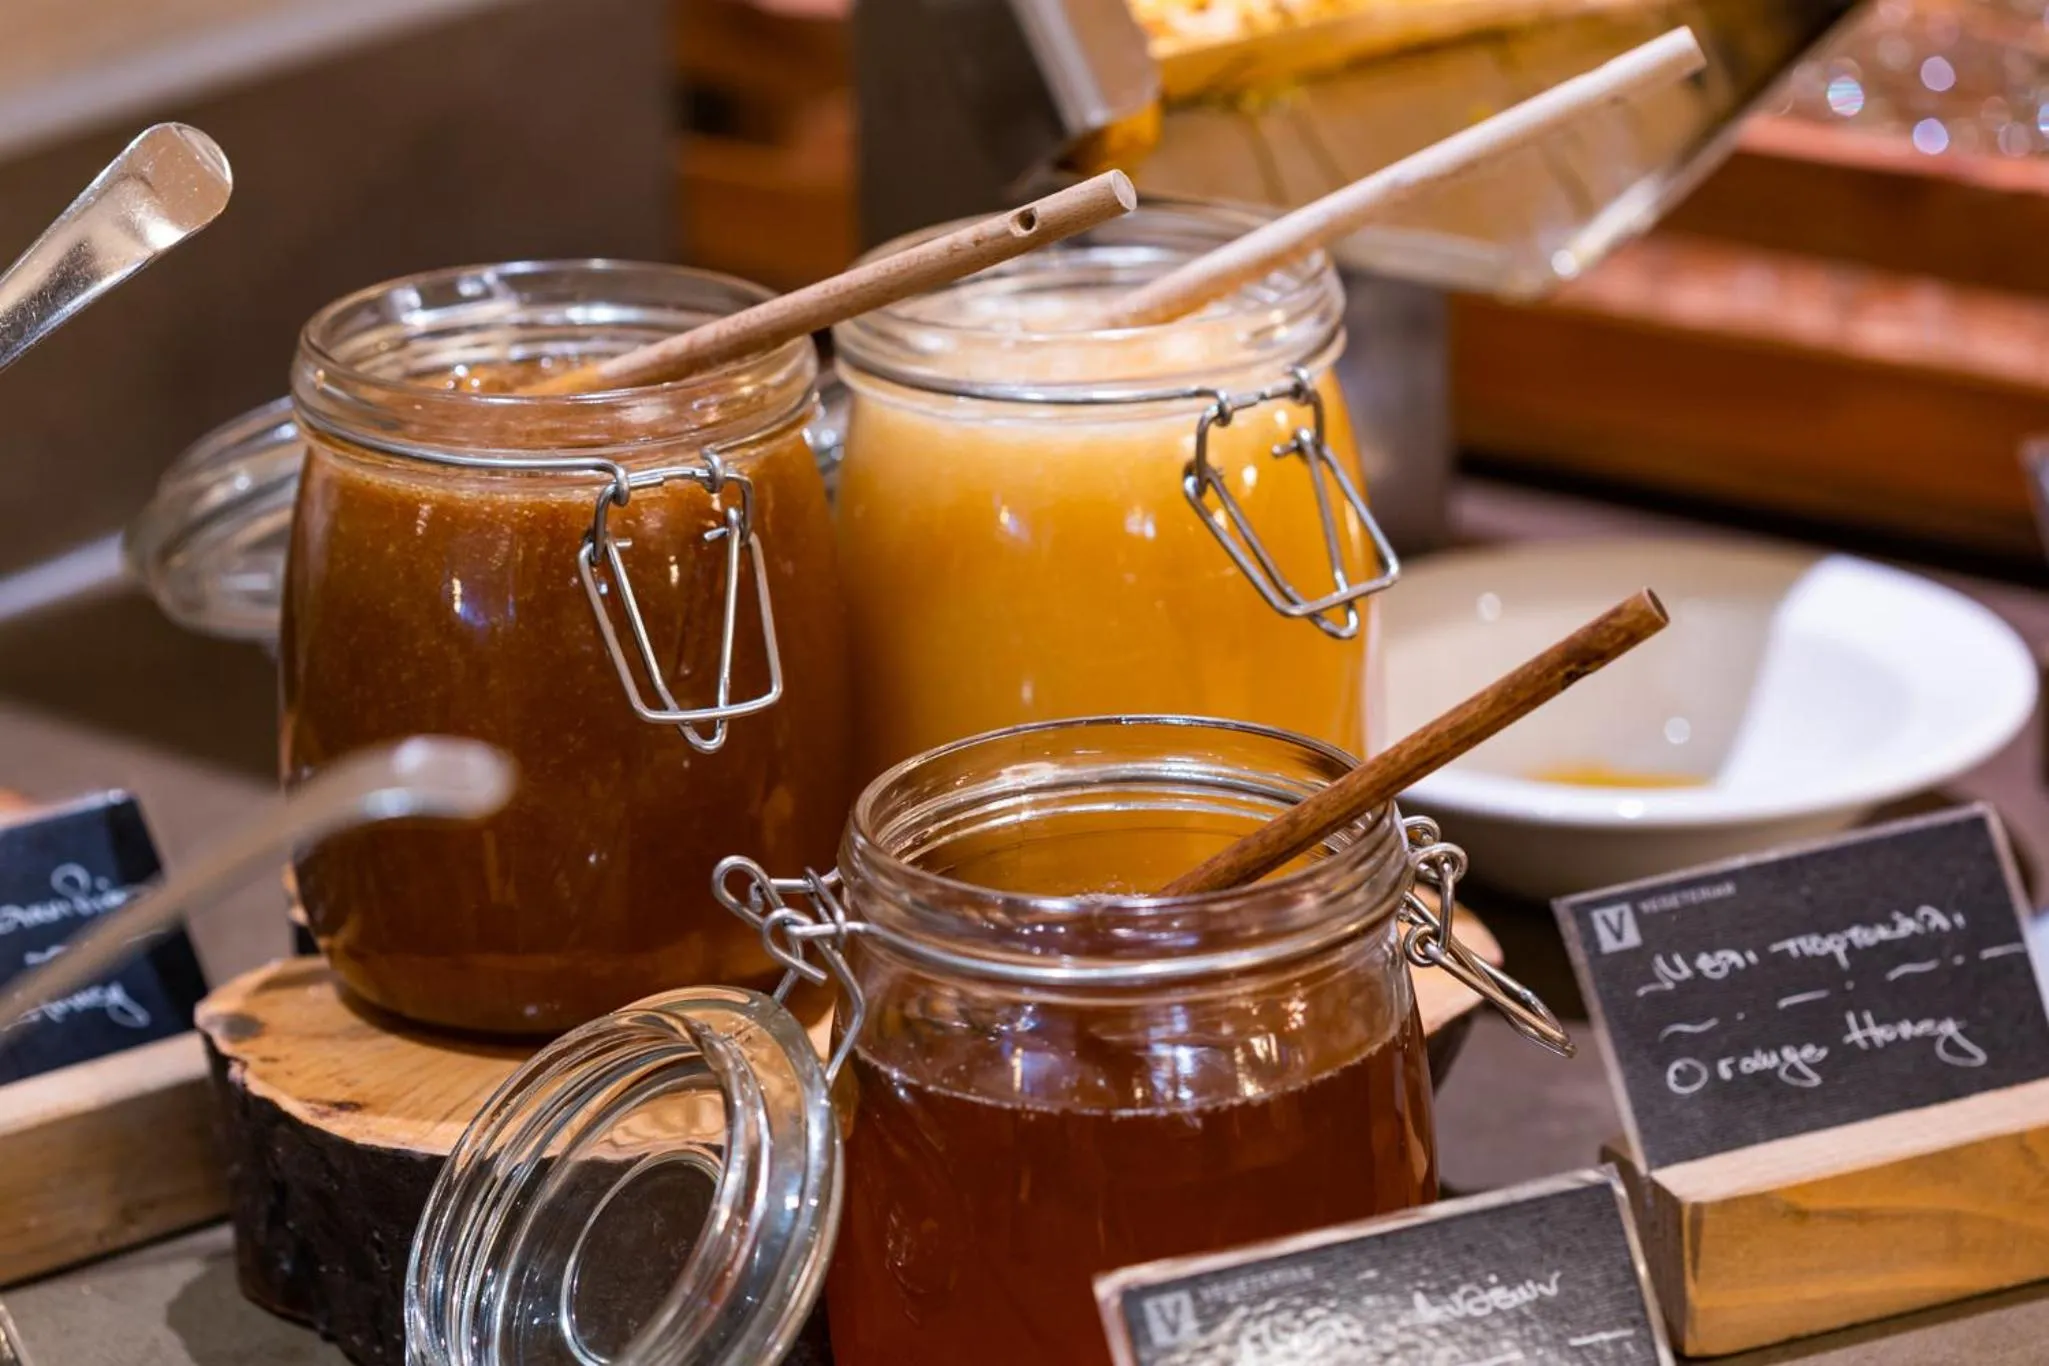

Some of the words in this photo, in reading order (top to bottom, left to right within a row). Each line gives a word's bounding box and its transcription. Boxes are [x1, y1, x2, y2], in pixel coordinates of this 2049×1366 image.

[1597, 909, 1634, 948] V
[1843, 1010, 1988, 1067] Honey
[1152, 1294, 1195, 1342] V
